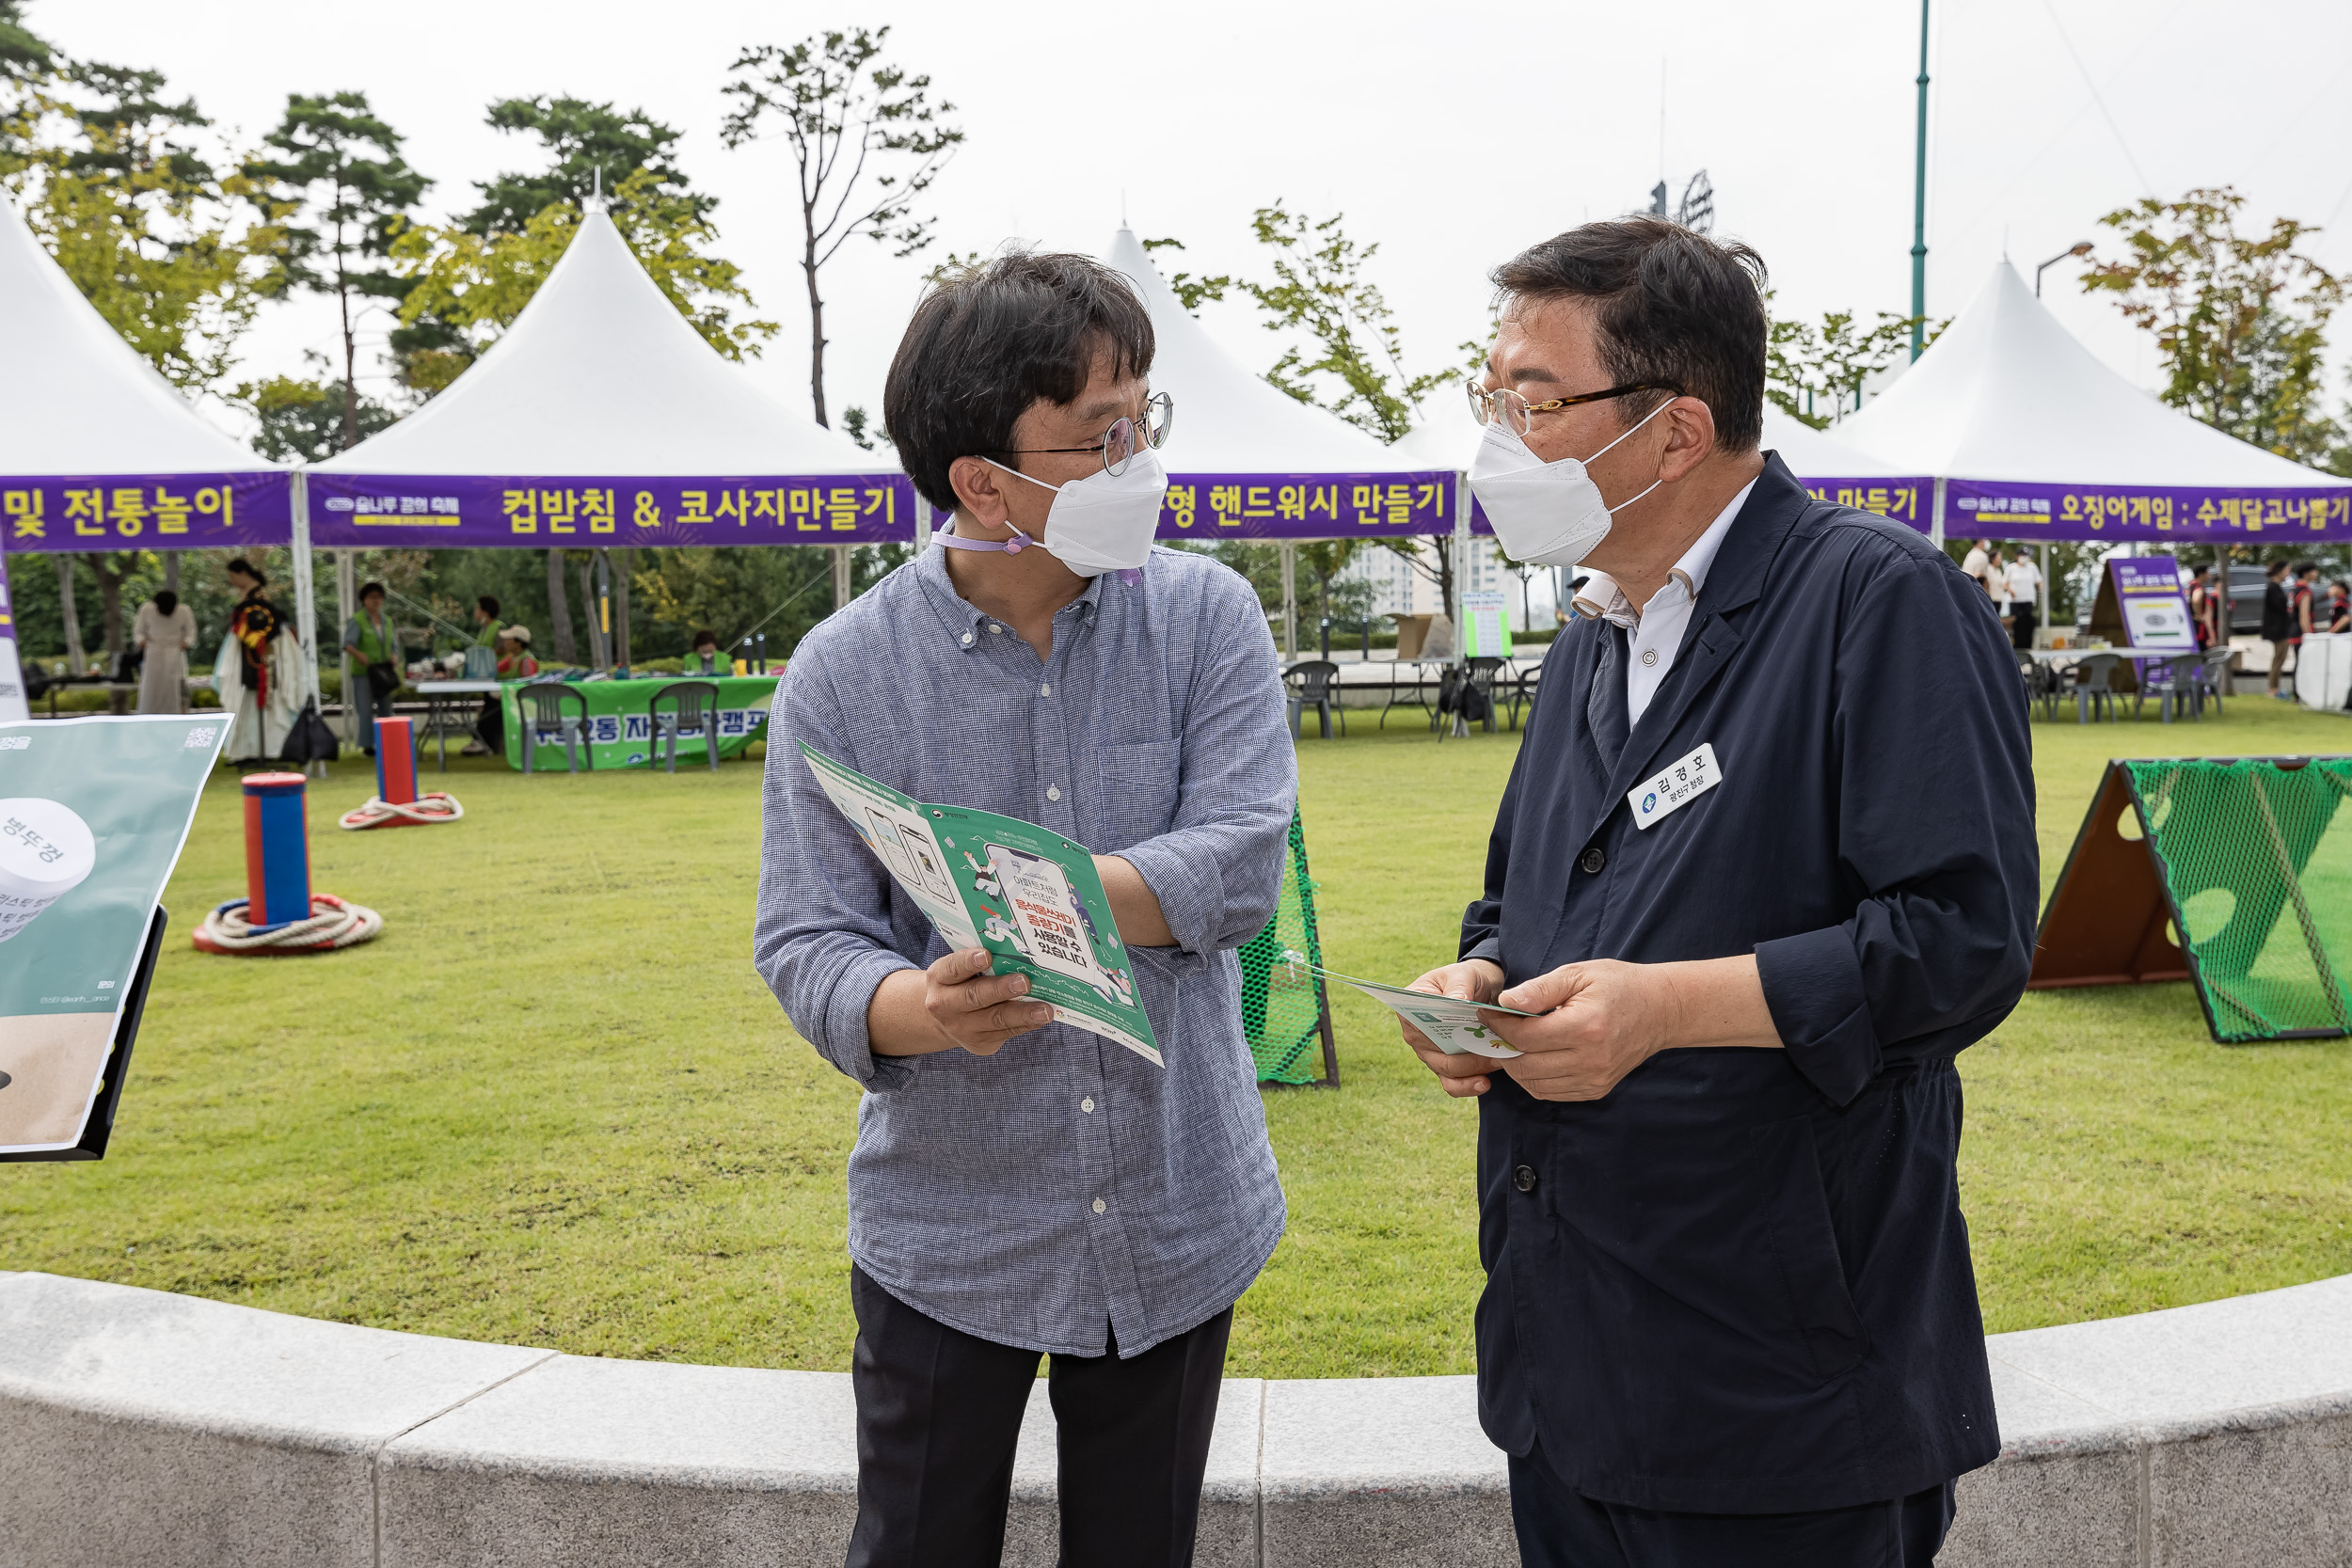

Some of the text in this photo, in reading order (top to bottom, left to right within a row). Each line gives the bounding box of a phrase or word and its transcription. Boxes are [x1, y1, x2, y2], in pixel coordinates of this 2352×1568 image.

[3, 484, 234, 538] 및 전통놀이
[502, 486, 895, 533] 컵받침 & 코사지만들기
[1209, 484, 1338, 527] 핸드워시
[1352, 482, 1444, 525] 만들기
[2059, 494, 2173, 530] 오징어게임
[3, 816, 64, 863] 병뚜껑
[1013, 875, 1058, 897] 아파트처럼
[1023, 888, 1058, 906] 우리집도
[1015, 898, 1077, 927] 음식물쓰레기
[1034, 927, 1082, 953] 사용할 수
[1038, 942, 1088, 968] 있습니다
